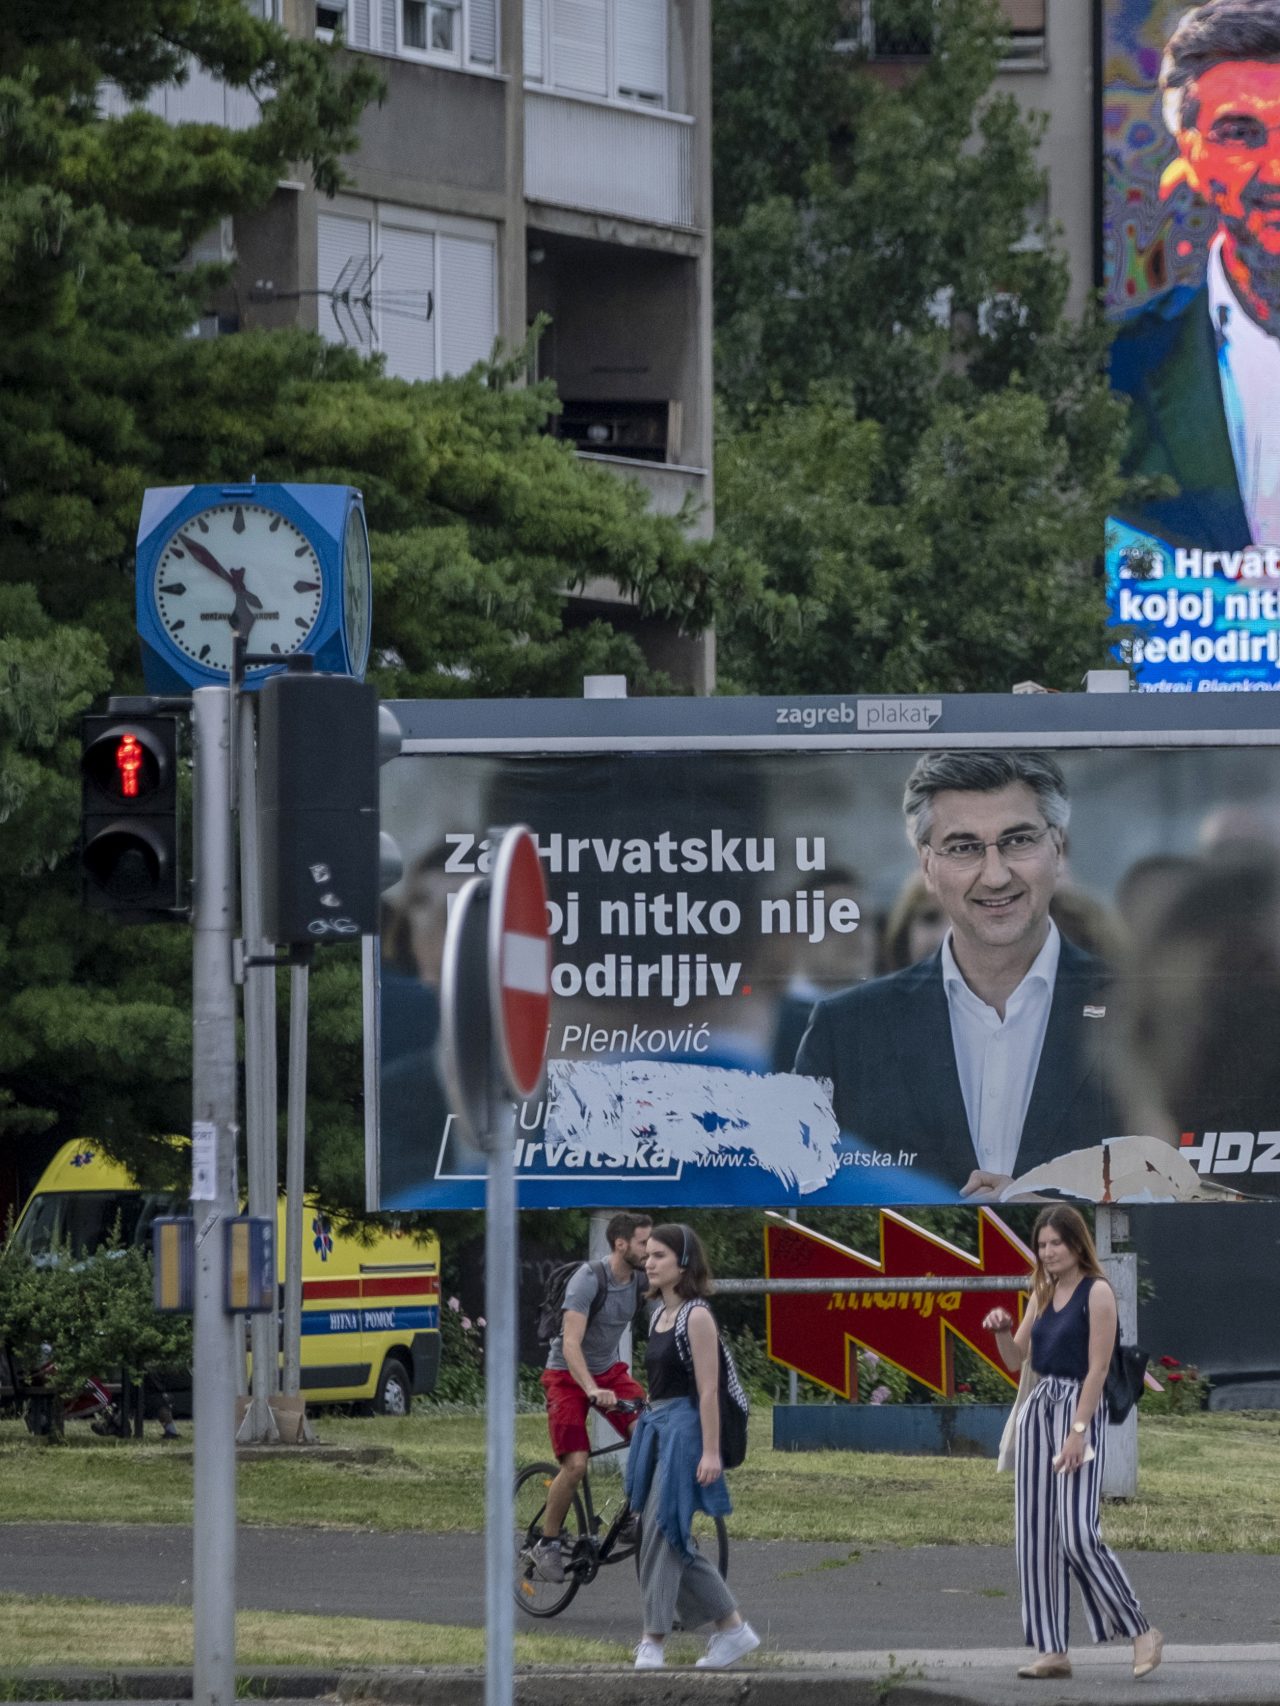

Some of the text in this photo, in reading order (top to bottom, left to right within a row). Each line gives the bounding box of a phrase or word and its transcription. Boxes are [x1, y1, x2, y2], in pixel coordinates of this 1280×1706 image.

[1119, 588, 1213, 628] kojoj
[776, 702, 930, 729] zagreb plakat
[536, 829, 775, 874] Hrvatsku
[795, 837, 826, 873] u
[600, 891, 742, 937] nitko
[760, 889, 861, 944] nije
[551, 954, 752, 1007] odirljiv.
[560, 1022, 711, 1054] Plenković
